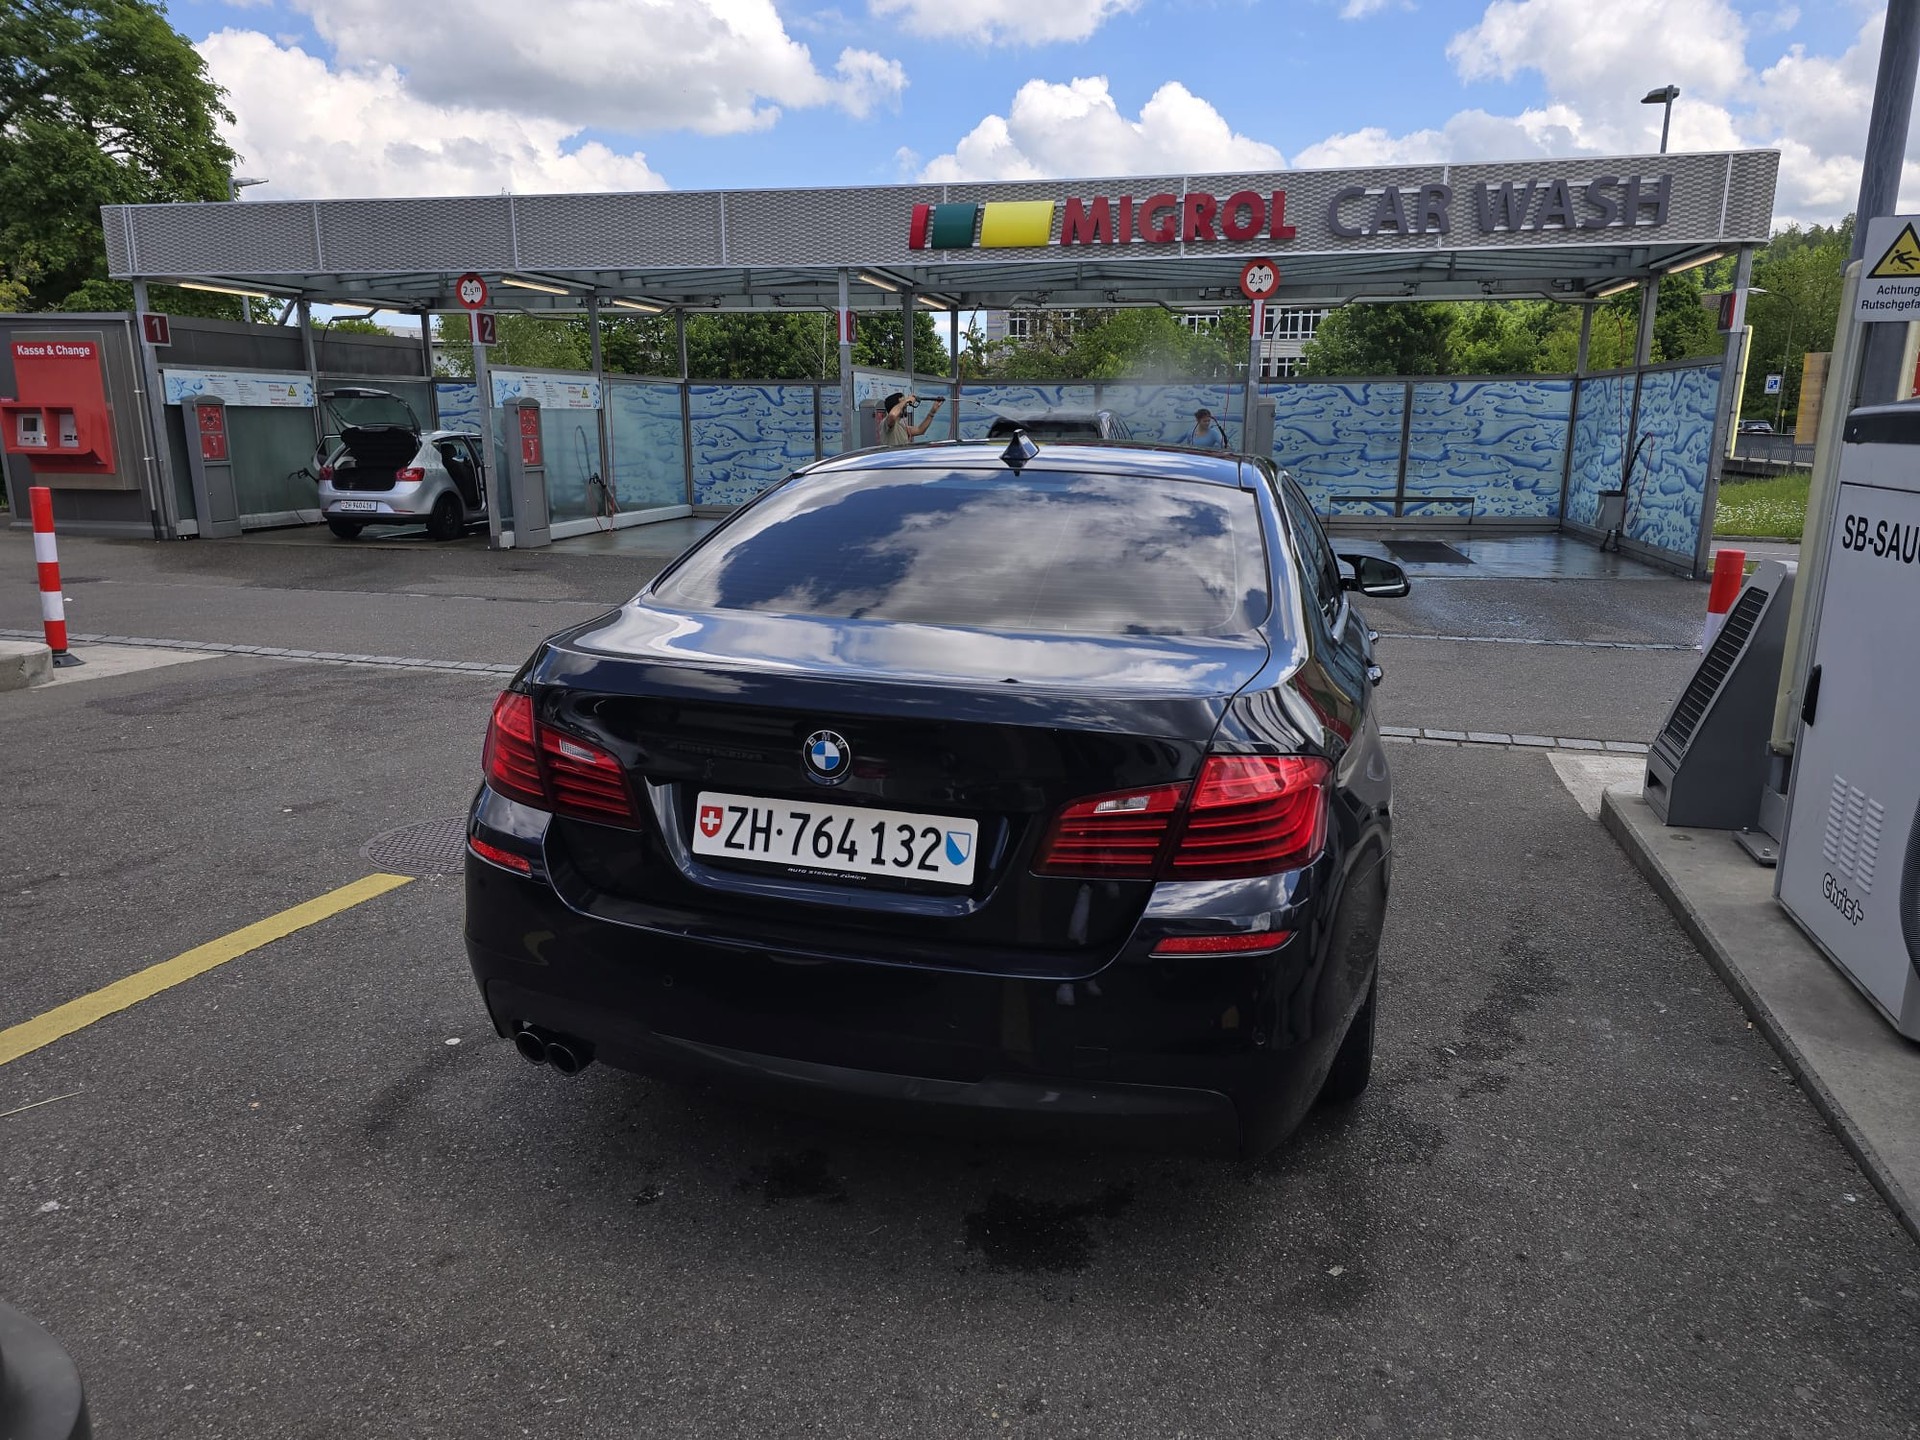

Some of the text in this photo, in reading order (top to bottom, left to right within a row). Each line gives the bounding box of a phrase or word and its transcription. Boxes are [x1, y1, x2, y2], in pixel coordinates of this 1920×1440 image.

[1060, 174, 1673, 246] MIGROL CAR WASH
[1876, 284, 1920, 297] Achtung
[152, 317, 162, 341] 1
[483, 316, 493, 341] 2
[17, 345, 91, 357] Kasse & Change
[1842, 514, 1920, 565] SB-SAU
[807, 731, 848, 749] BMW
[1823, 872, 1864, 926] Christ
